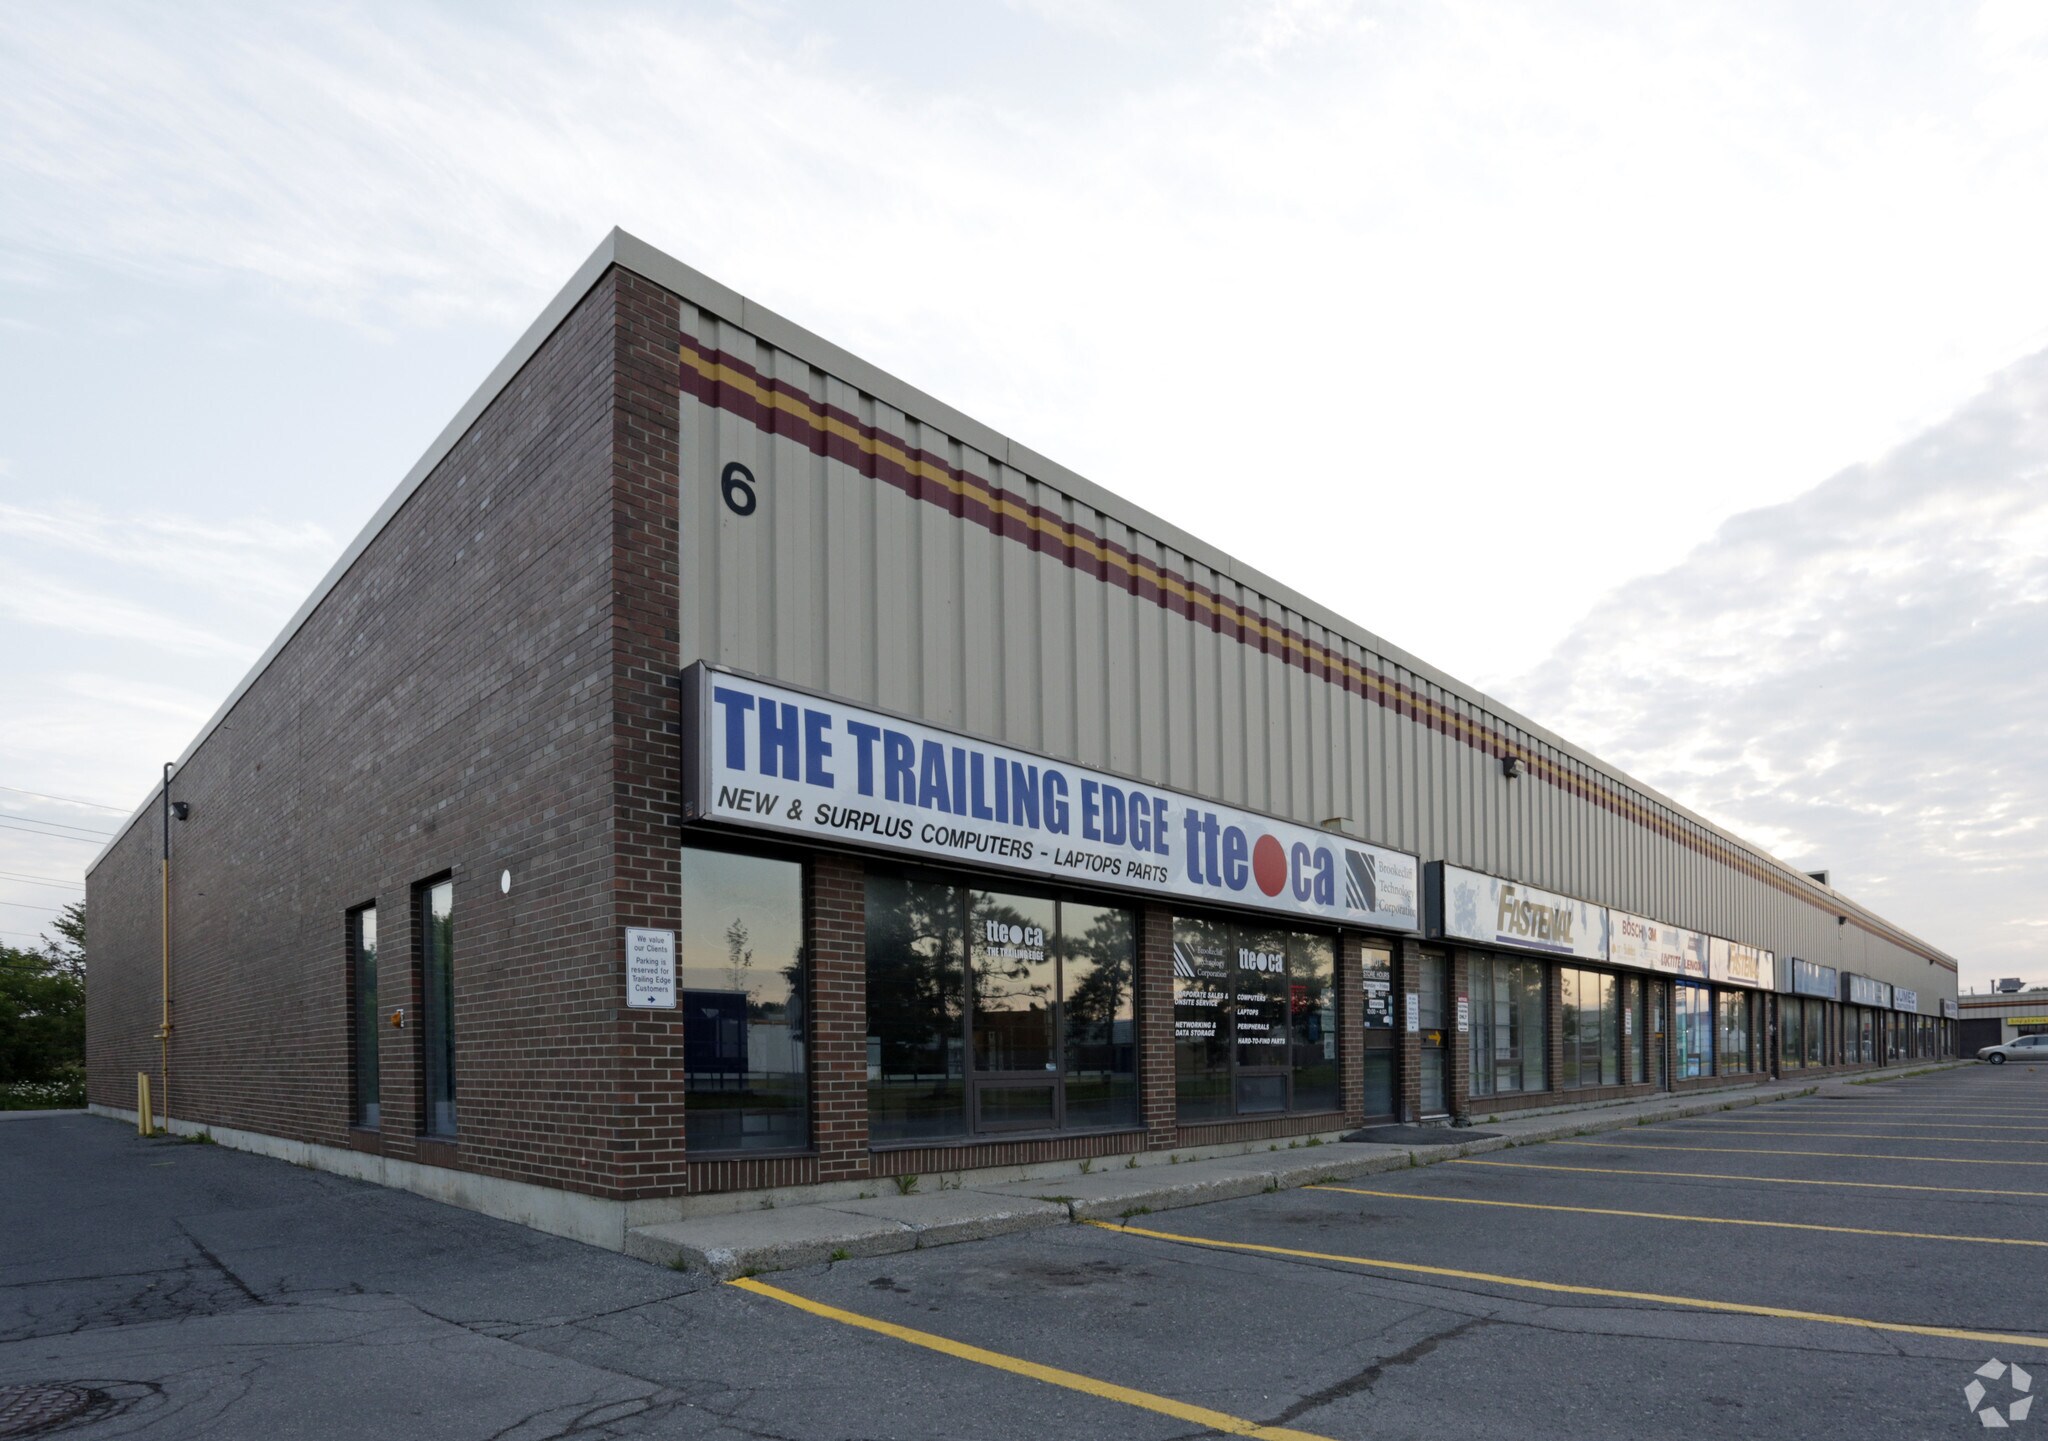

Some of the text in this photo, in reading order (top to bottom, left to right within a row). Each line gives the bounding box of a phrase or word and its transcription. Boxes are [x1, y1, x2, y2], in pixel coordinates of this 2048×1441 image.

[721, 461, 757, 517] 6
[714, 686, 1170, 857] THE TRAILING EDGE
[717, 785, 779, 816] NEW
[786, 799, 803, 821] &
[814, 803, 913, 839] SURPLUS
[920, 823, 1034, 860] COMPUTERS
[1053, 847, 1122, 876] LAPTOPS
[1125, 860, 1168, 884] PARTS
[1379, 880, 1414, 903] Technology
[1497, 884, 1573, 944] FASTENAL
[637, 935, 646, 943] We
[1622, 920, 1657, 942] BOSCH 3M
[646, 945, 668, 953] Clients
[987, 946, 1044, 960] THE TRAILING EDGE
[636, 957, 658, 966] Parking
[632, 975, 672, 985] Trailing Edge
[635, 984, 668, 992] Customers
